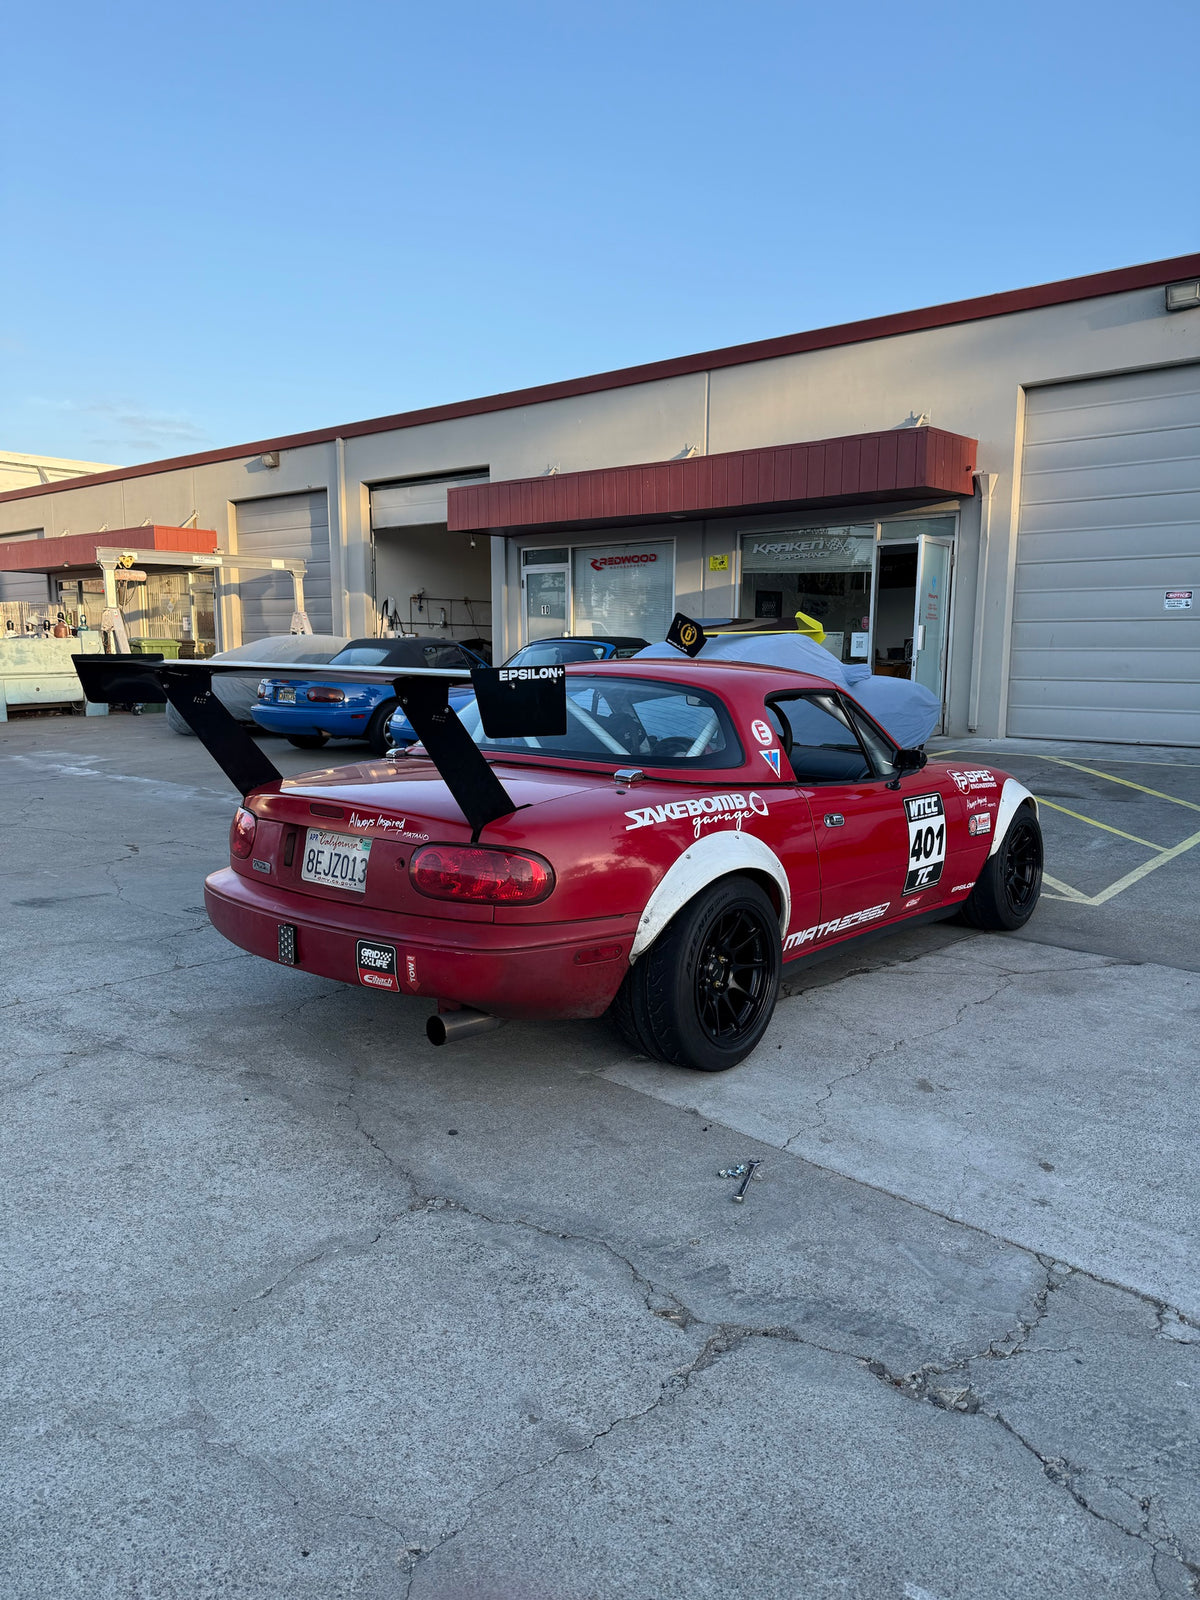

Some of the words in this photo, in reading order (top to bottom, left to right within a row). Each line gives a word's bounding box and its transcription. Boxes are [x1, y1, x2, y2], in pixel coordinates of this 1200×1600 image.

[752, 540, 825, 556] KRAKEN
[599, 553, 657, 566] REDWOOD
[499, 667, 565, 682] EPSILON+
[963, 770, 995, 782] SPEC
[624, 793, 748, 831] SAKEBOMB
[909, 796, 939, 817] WTCC
[348, 812, 375, 831] Always
[377, 814, 405, 831] Inspired
[692, 808, 755, 839] garage
[320, 832, 363, 851] California
[910, 823, 945, 862] 401
[306, 848, 368, 883] 8EJZ013
[915, 865, 934, 886] TC
[361, 948, 381, 959] GRID
[371, 959, 389, 969] LIFE
[408, 962, 416, 982] TOW
